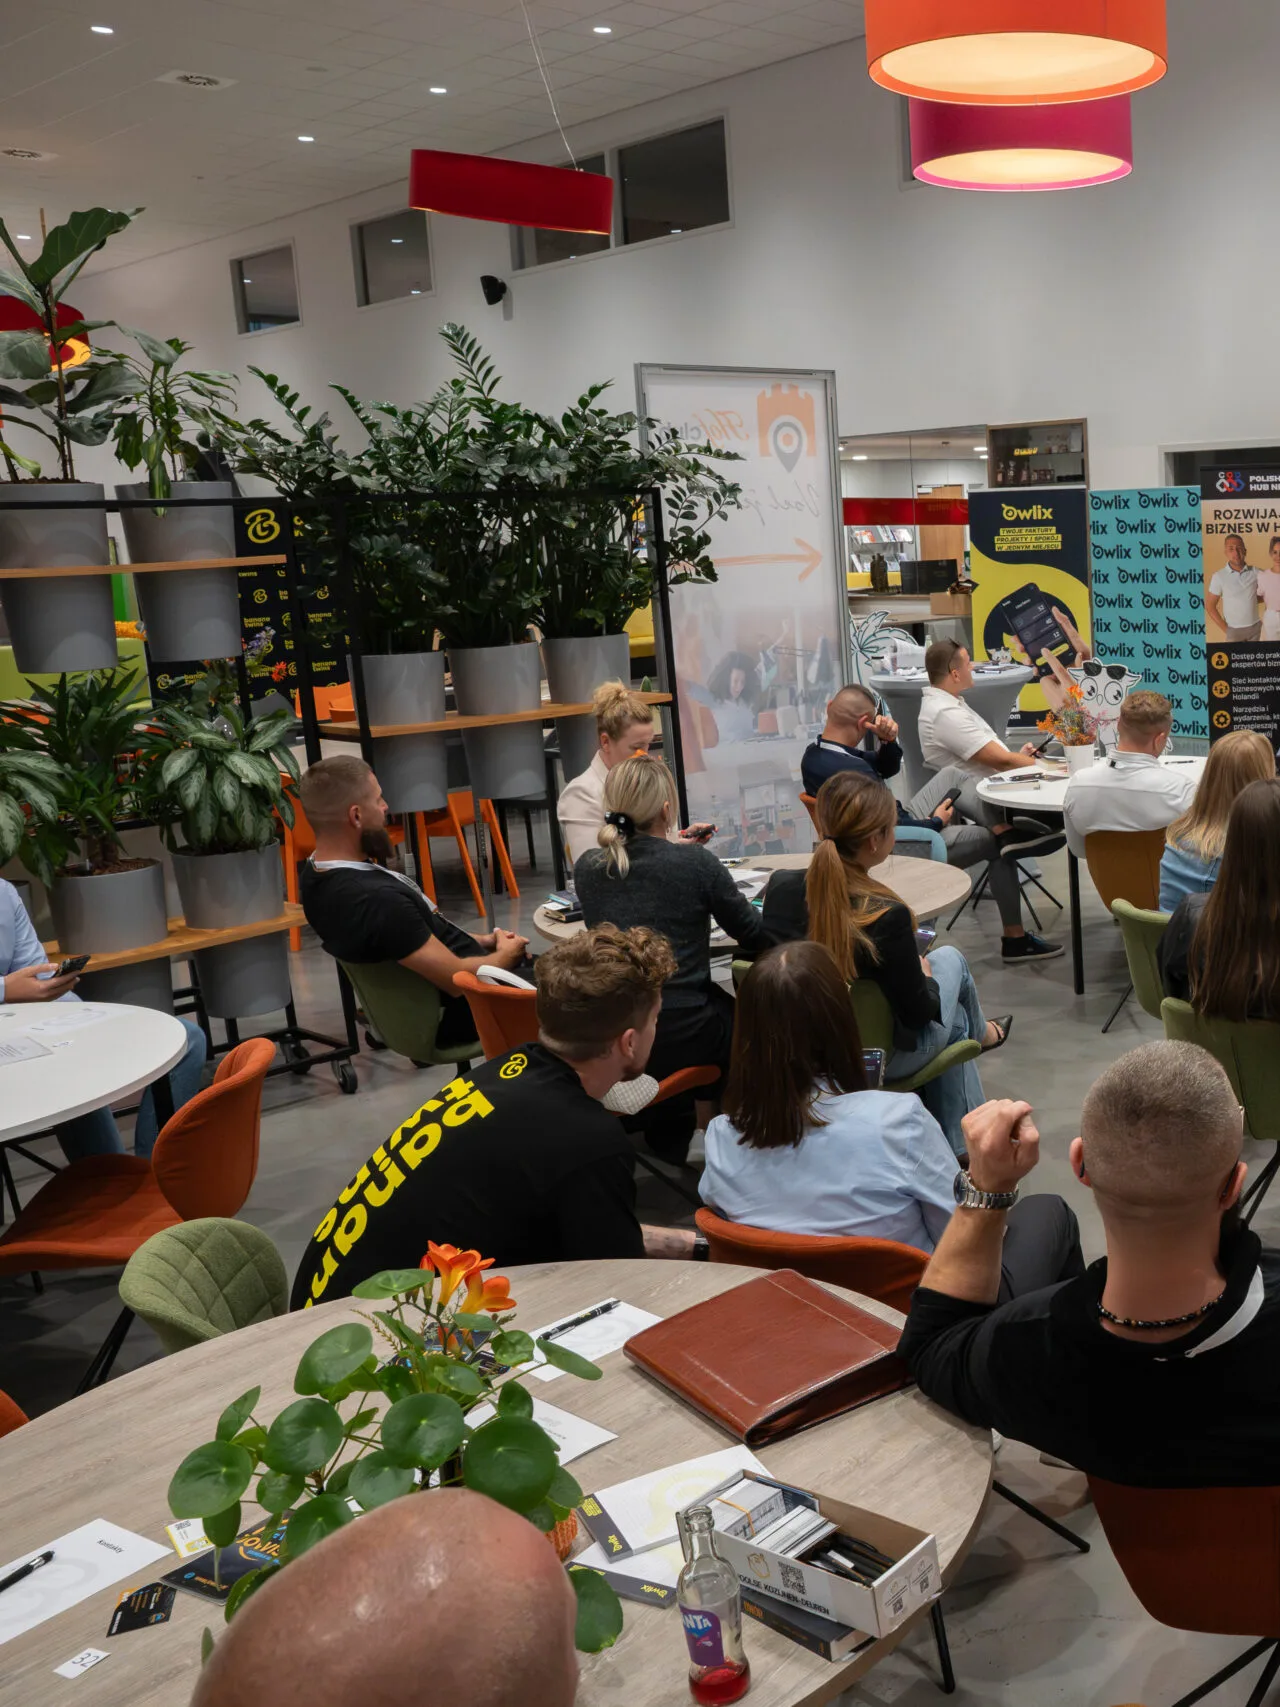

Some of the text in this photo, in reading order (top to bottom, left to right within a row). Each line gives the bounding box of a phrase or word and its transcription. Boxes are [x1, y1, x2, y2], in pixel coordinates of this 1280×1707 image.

[1250, 484, 1269, 492] HUB
[1090, 493, 1130, 510] Owlix
[1138, 491, 1179, 509] Owlix
[1001, 503, 1053, 521] Owlix
[1115, 517, 1156, 534] Owlix
[1205, 523, 1253, 535] BIZNES
[1256, 521, 1270, 533] W
[1092, 542, 1132, 559] Owlix
[1139, 541, 1180, 559] Owlix
[1117, 566, 1158, 584] Owlix
[1093, 591, 1133, 608] Owlix
[1141, 591, 1181, 609] Owlix
[1119, 616, 1159, 633] Owlix
[1095, 640, 1135, 657] Owlix
[1142, 641, 1182, 659] Owlix
[1231, 653, 1255, 661] Dostęp
[1231, 660, 1266, 668] ekspertów
[1167, 666, 1207, 686] Owlix
[1232, 677, 1246, 685] Sieć
[1232, 685, 1274, 693] biznesowych
[1233, 706, 1265, 714] Narzędzia
[1171, 719, 1208, 736] Owlix
[1233, 722, 1278, 731] przyspieszają
[304, 1089, 495, 1310] banan
[71, 1653, 100, 1668] 32
